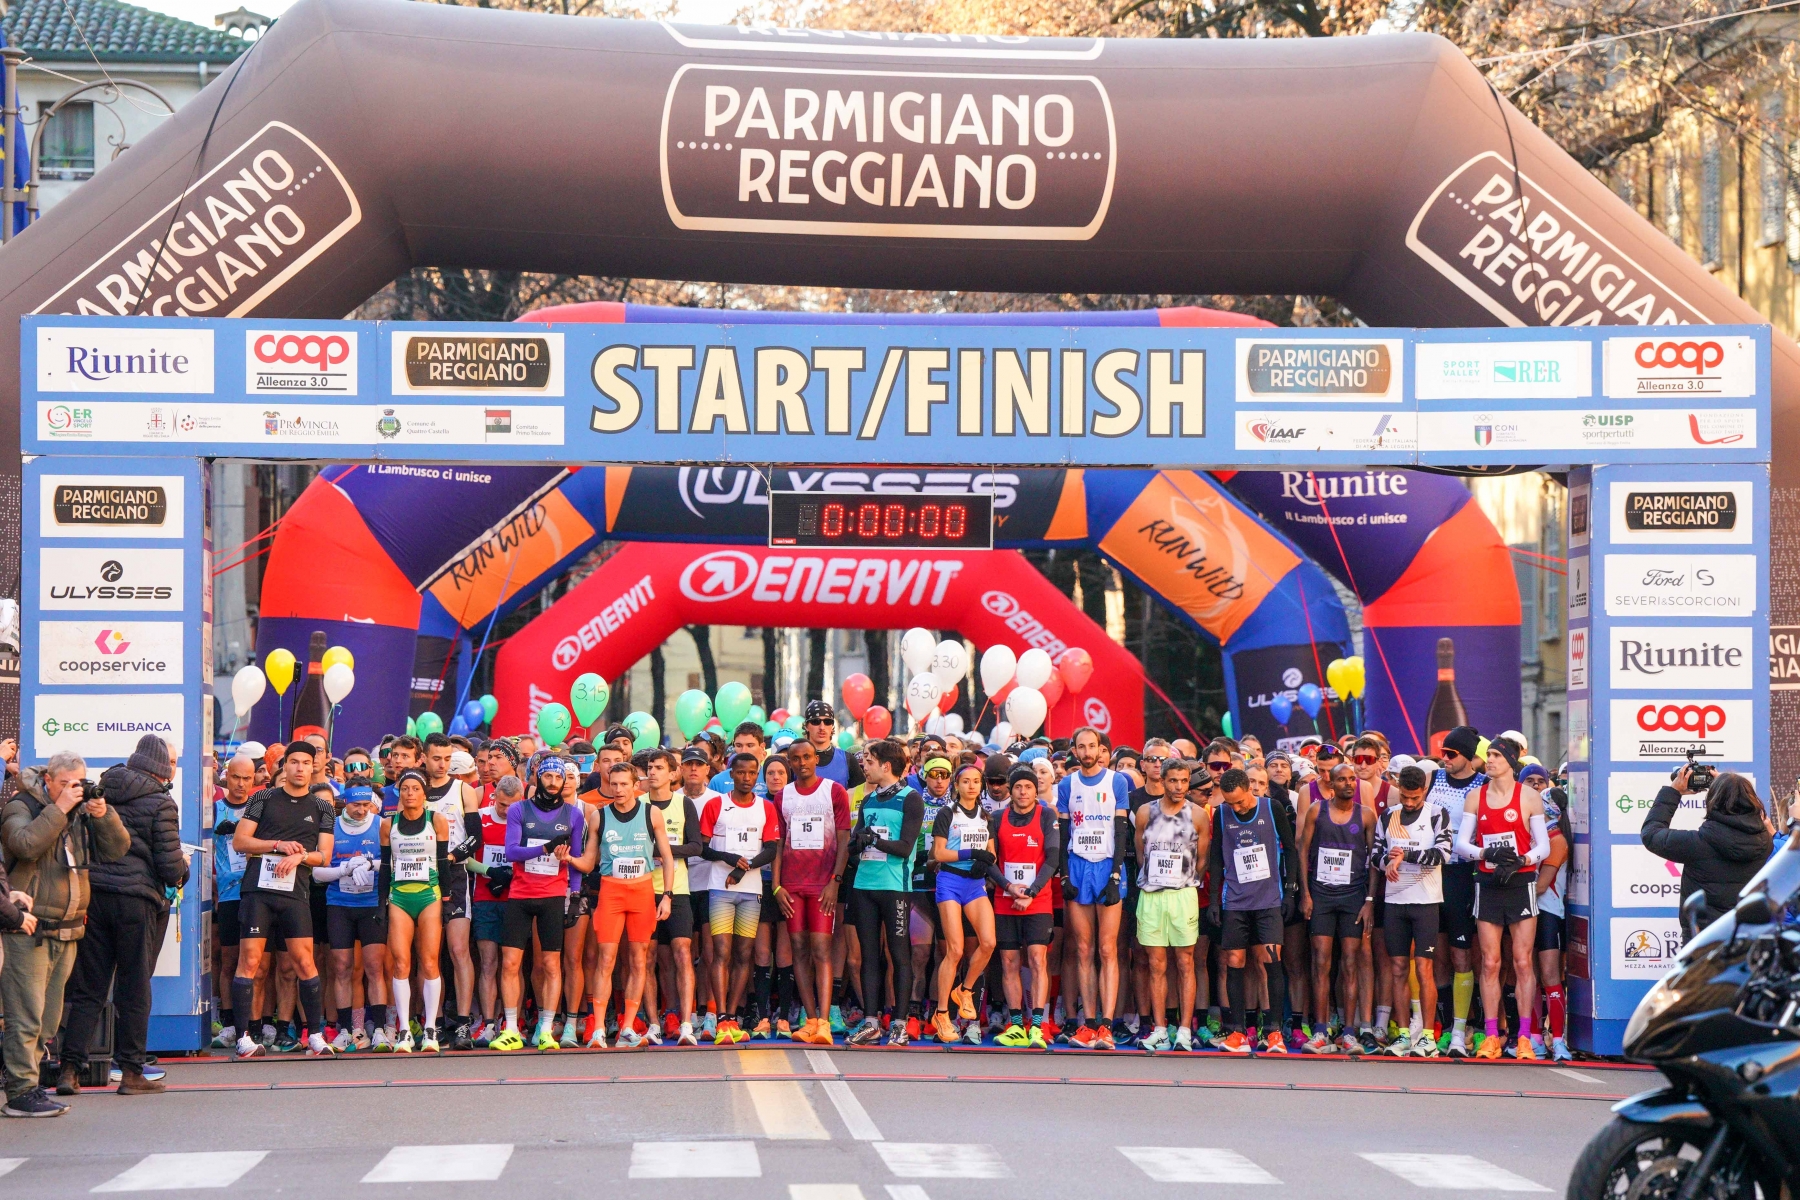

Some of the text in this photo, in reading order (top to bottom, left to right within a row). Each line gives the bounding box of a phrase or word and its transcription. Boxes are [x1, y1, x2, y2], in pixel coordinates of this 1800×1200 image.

[704, 85, 1074, 147] PARMIGIANO
[738, 148, 1037, 210] REGGIANO
[59, 150, 294, 316] ARMIGIANO
[1471, 173, 1690, 326] PARMIGIA
[139, 205, 305, 316] GGIANO
[254, 334, 349, 371] coop
[417, 342, 539, 361] PARMIGIANO
[1258, 349, 1380, 368] PARMIGIANO
[1635, 341, 1724, 375] coop
[66, 346, 188, 380] Riunite
[429, 362, 527, 381] REGGIANO
[257, 376, 328, 387] Alleanza 3.0
[1270, 369, 1367, 388] REGGIANO
[1443, 369, 1480, 377] VALLEY
[589, 344, 1206, 440] START/FINISH
[1637, 379, 1704, 391] Alleanza 3.0
[280, 419, 339, 430] PROVINCIA
[1598, 415, 1634, 426] UISP
[1270, 428, 1306, 438] IAAF
[1582, 428, 1634, 440] sportpertutti
[378, 465, 439, 479] Lambrusco
[442, 468, 452, 480] ci
[455, 471, 492, 484] unisce
[1280, 471, 1408, 505] Riunite
[63, 489, 158, 505] PARMIGIANO
[1634, 495, 1728, 510] PARMIGIANO
[72, 505, 149, 520] REGGIANO
[822, 503, 965, 537] 0:00:00
[1285, 511, 1408, 526] Il Lambrusco ci unisce
[1643, 510, 1719, 525] REGGIANO
[450, 503, 547, 590] RUN WILD
[1138, 519, 1243, 600] RUN WILD
[752, 556, 963, 606] ENERVIT
[1642, 569, 1685, 587] Ford
[50, 586, 172, 600] ULYSSES
[1615, 595, 1741, 607] SEVERI&SCORCIONI
[577, 574, 656, 652] ENERVIT
[1619, 640, 1742, 675] Riunite
[59, 658, 166, 675] coopservice
[575, 682, 607, 702] 3.15
[910, 682, 939, 700] 3.30
[64, 722, 172, 732] BCC EMILBANCA
[1636, 704, 1726, 738] coop
[1639, 744, 1686, 754] Alleanza
[802, 822, 813, 833] 15
[737, 832, 748, 843] 14
[1078, 835, 1102, 845] CARRERA
[618, 844, 644, 852] ENERGY
[618, 865, 641, 874] FERRATO
[1242, 856, 1258, 866] BATEL
[1323, 856, 1345, 866] SHUMAY
[1013, 869, 1024, 880] 18
